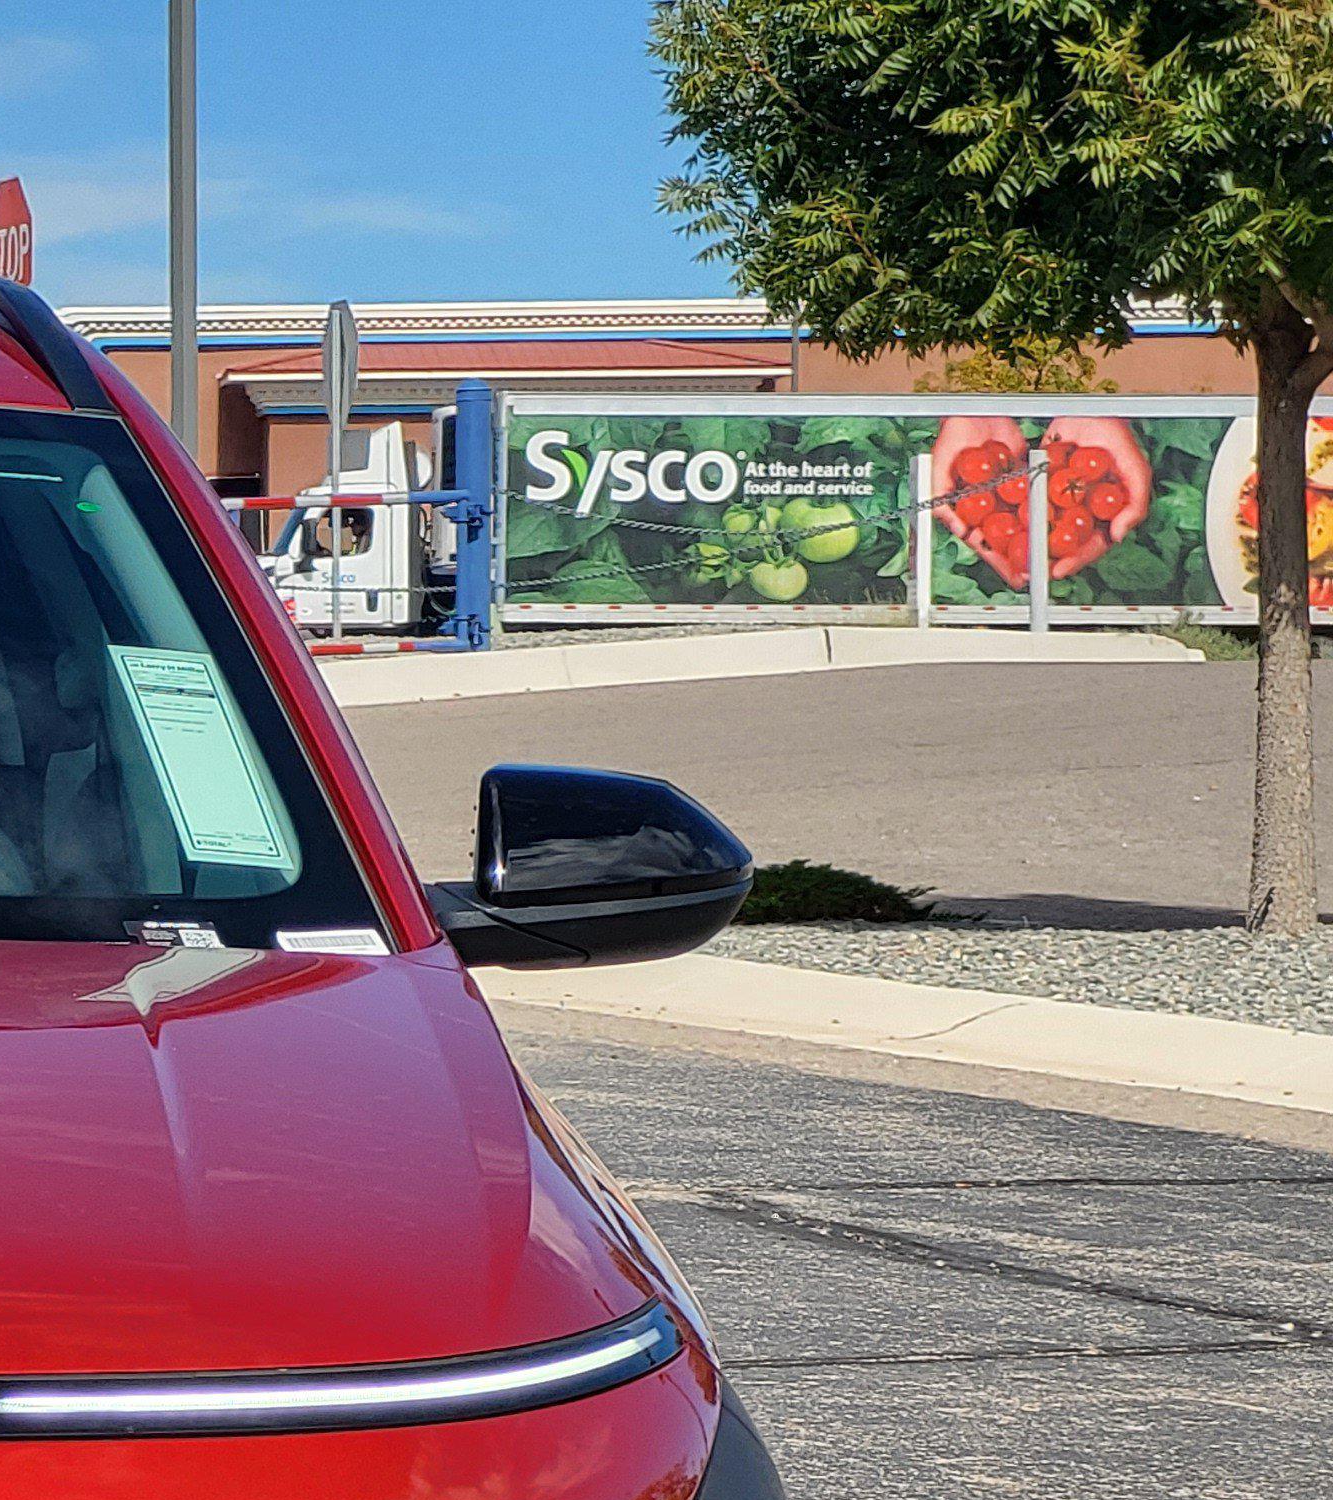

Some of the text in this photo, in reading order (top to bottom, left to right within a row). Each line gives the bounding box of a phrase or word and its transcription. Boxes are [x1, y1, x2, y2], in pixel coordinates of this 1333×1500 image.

[526, 430, 739, 518] Sysco
[744, 461, 874, 478] At the heart of
[743, 480, 874, 496] food and service
